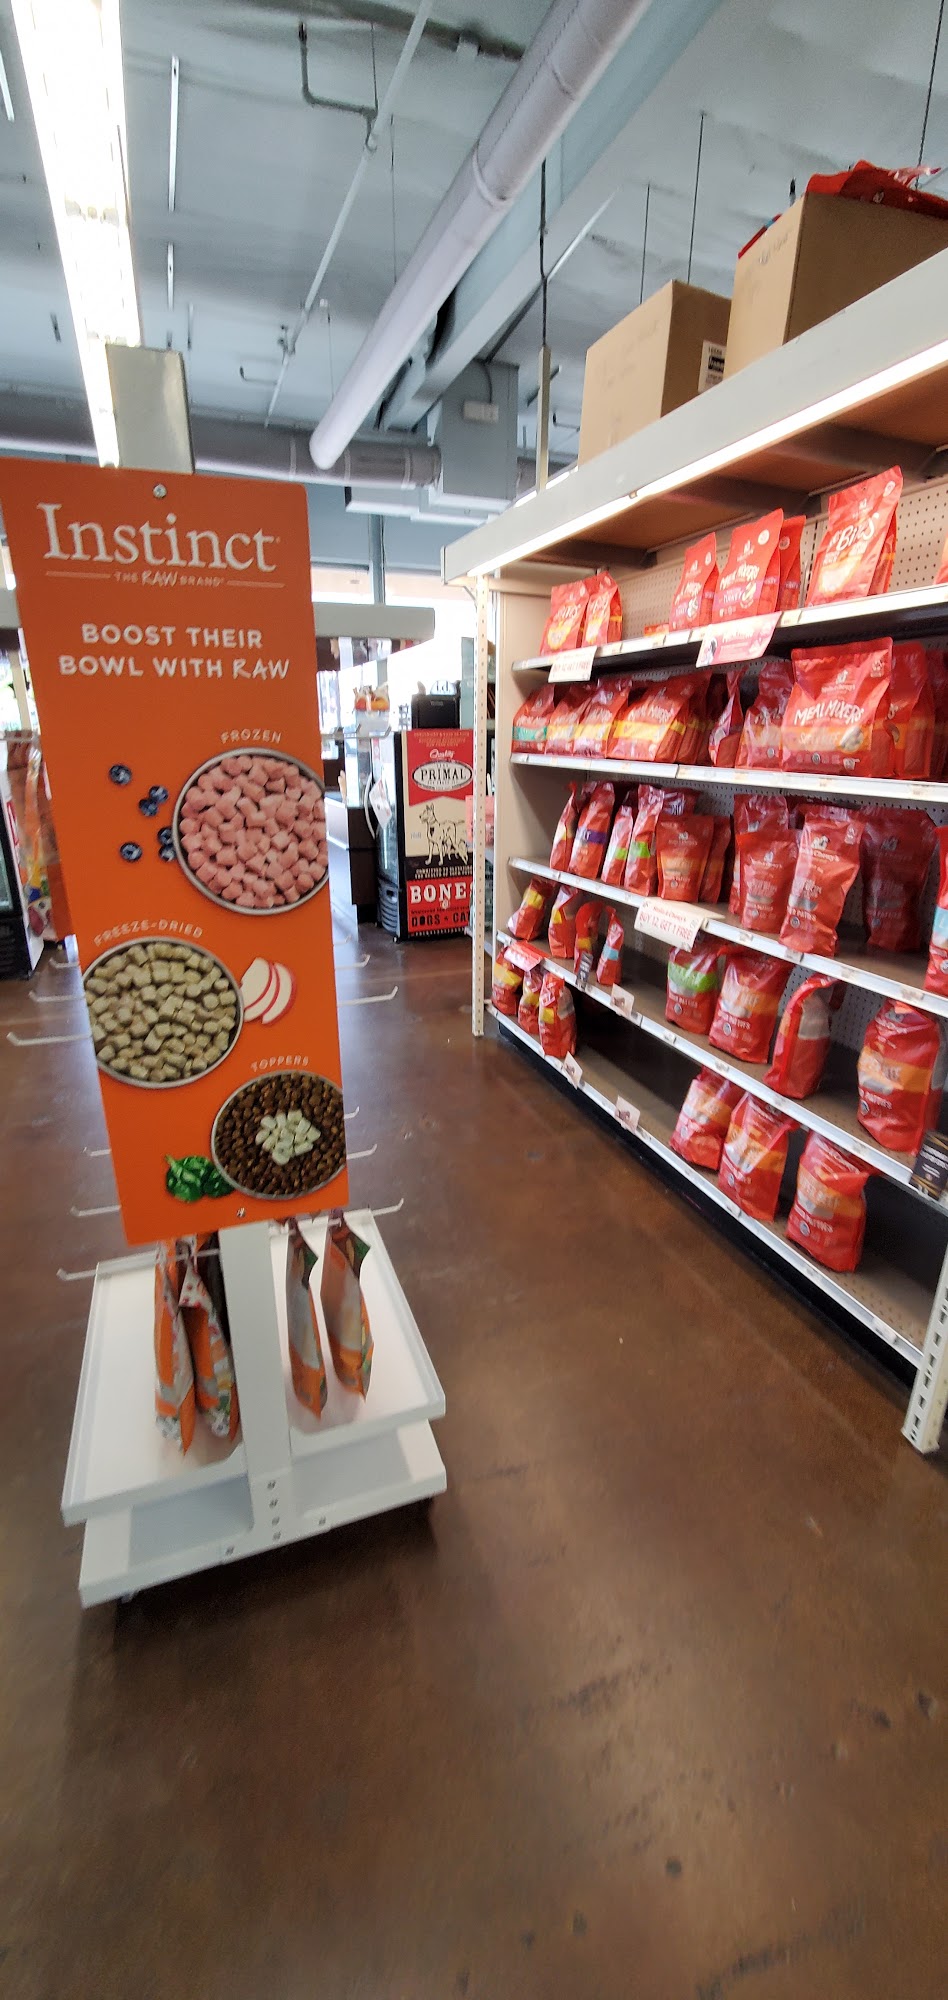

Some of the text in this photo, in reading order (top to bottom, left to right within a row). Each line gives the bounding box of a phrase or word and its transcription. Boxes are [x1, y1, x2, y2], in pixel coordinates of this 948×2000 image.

[37, 502, 277, 572] Instinct
[114, 570, 223, 587] THE RAW BRAND
[81, 623, 263, 649] BOOST THEIR
[58, 655, 290, 681] BOWL WITH RAW
[794, 703, 826, 726] MEAL
[220, 728, 282, 744] FROZEN
[421, 768, 466, 781] PRIMAL
[410, 882, 473, 904] BONE
[411, 914, 440, 927] DOGS
[250, 1055, 309, 1073] TOPPERS
